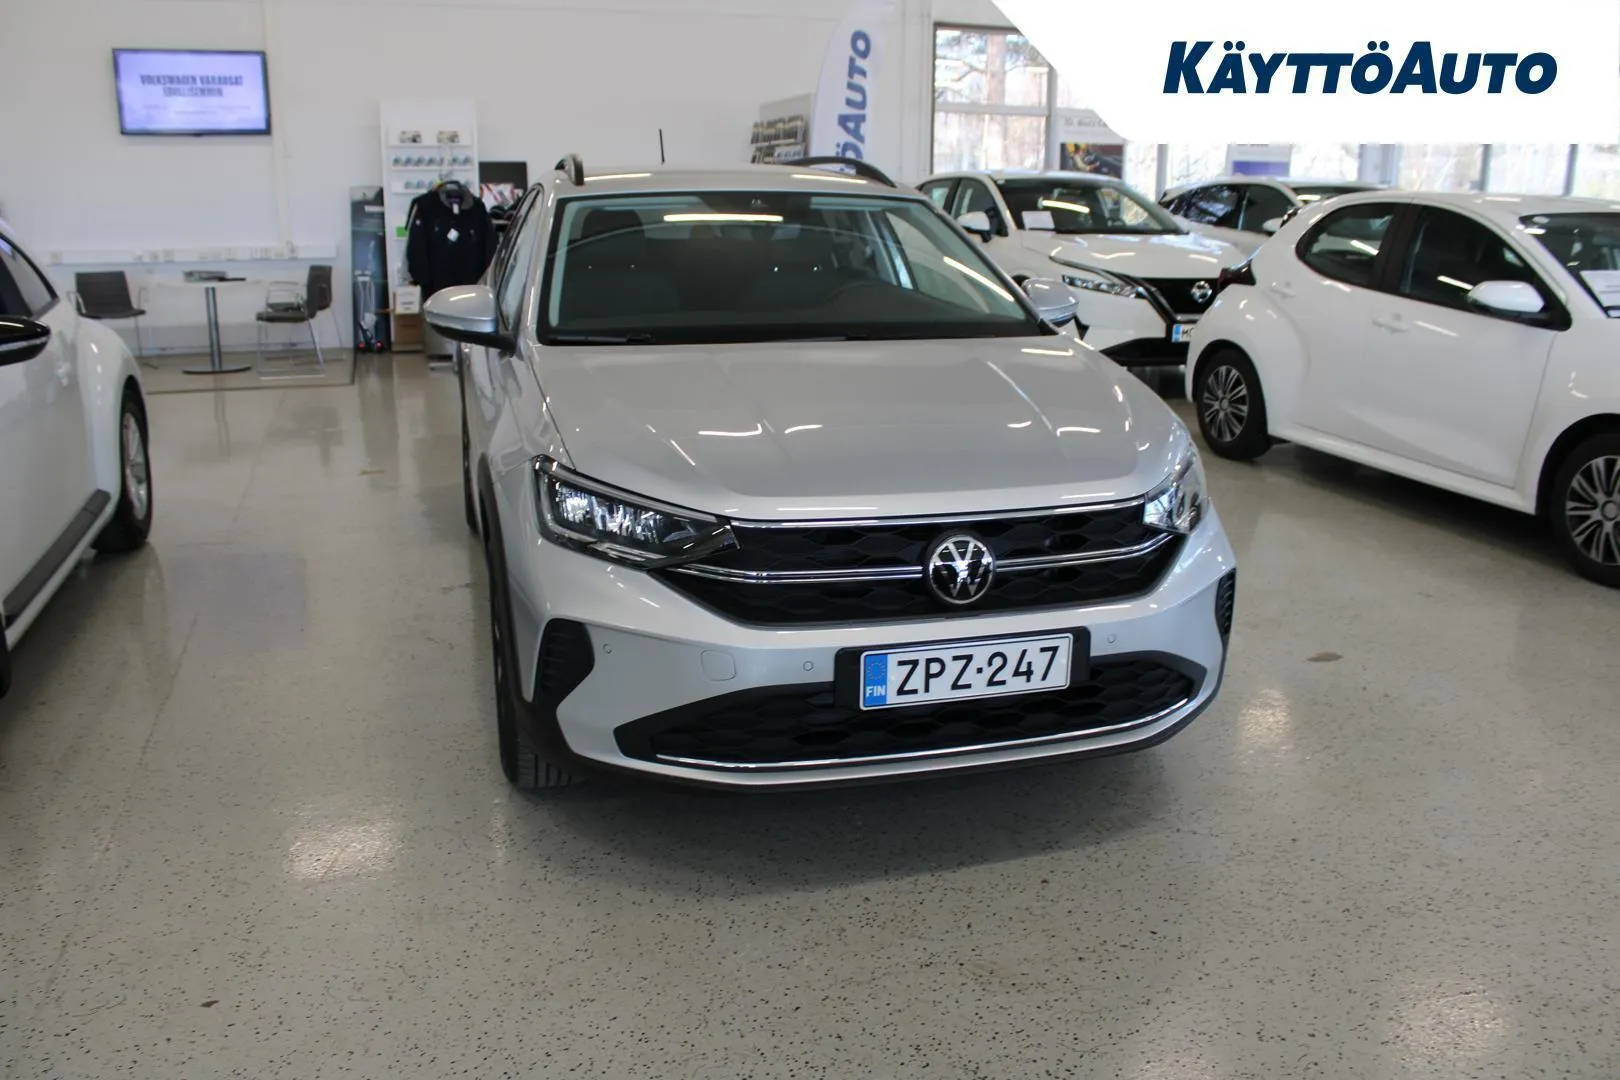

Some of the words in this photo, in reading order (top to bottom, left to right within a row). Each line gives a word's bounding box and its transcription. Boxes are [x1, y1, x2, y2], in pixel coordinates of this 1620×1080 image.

[139, 74, 197, 86] VOLKSWAGEN
[896, 645, 1061, 697] ZPZ-247
[865, 684, 886, 697] FIN
